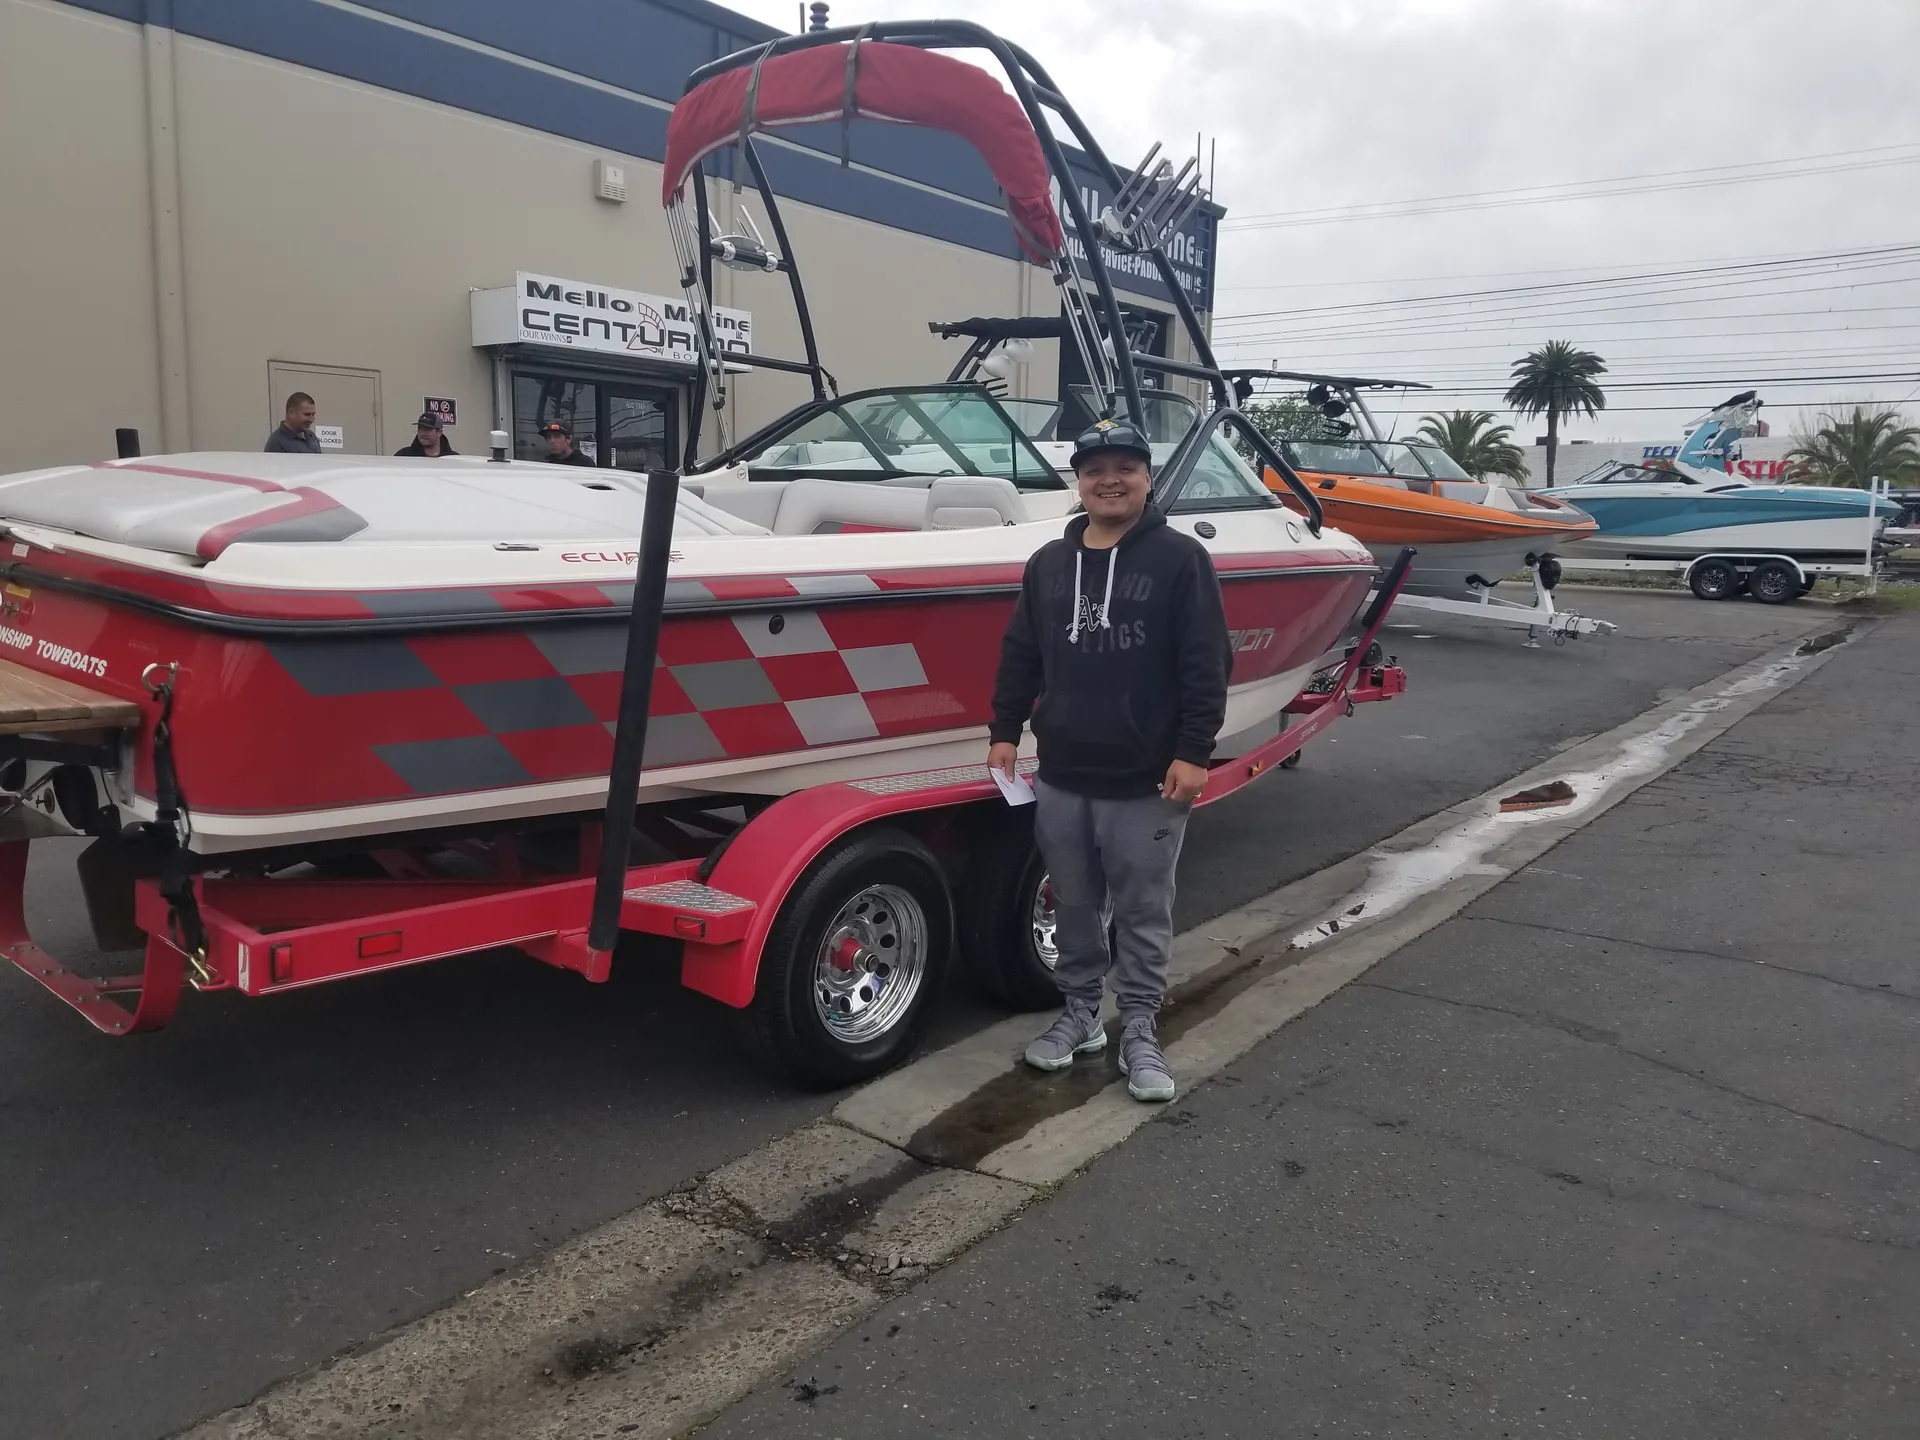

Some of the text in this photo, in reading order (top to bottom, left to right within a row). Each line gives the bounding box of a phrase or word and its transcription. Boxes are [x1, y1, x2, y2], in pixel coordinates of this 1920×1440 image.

[526, 279, 634, 314] Mello
[430, 400, 439, 411] NO
[561, 551, 685, 563] ECLIPE
[36, 639, 108, 677] TOWBOATS
